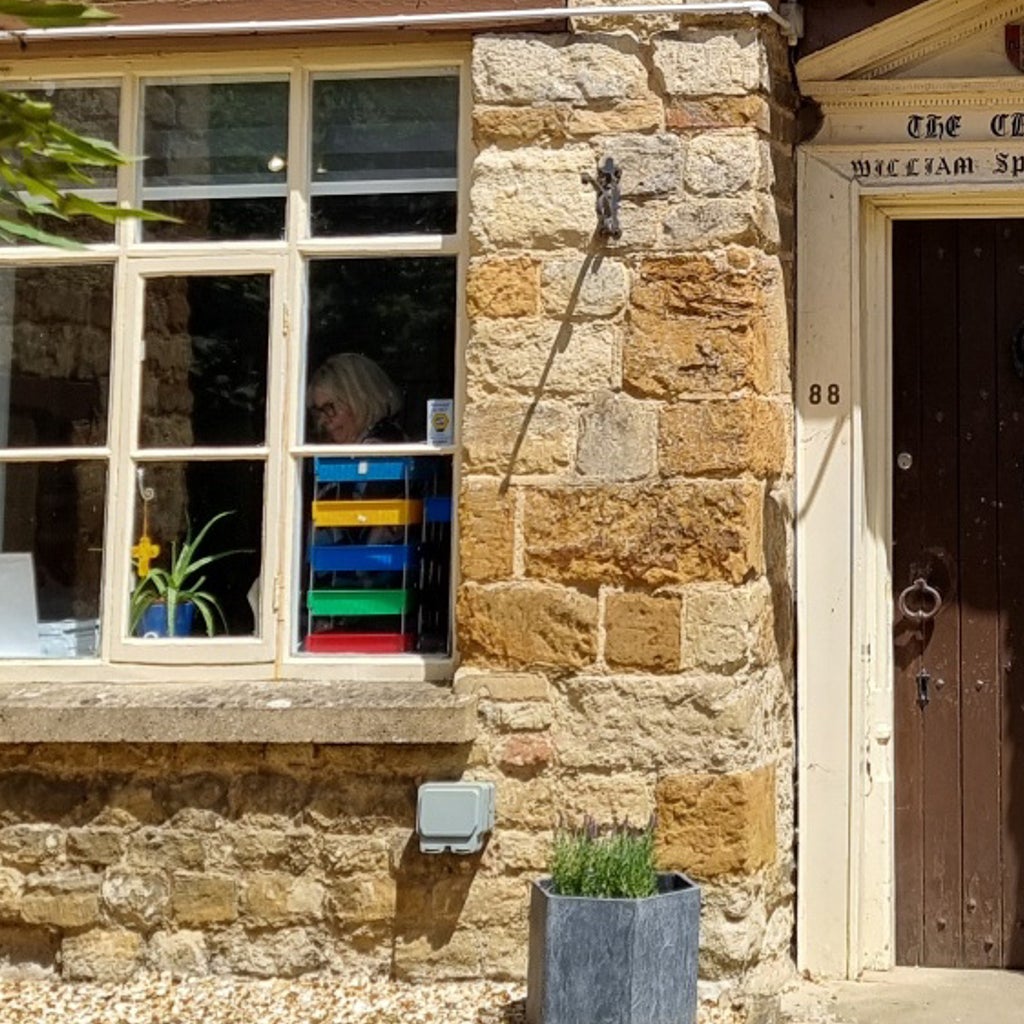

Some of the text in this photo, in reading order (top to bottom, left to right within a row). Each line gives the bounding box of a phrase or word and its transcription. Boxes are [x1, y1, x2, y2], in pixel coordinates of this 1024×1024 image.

[907, 114, 961, 139] THE
[850, 155, 975, 178] WILLIAM
[809, 384, 840, 405] 88
